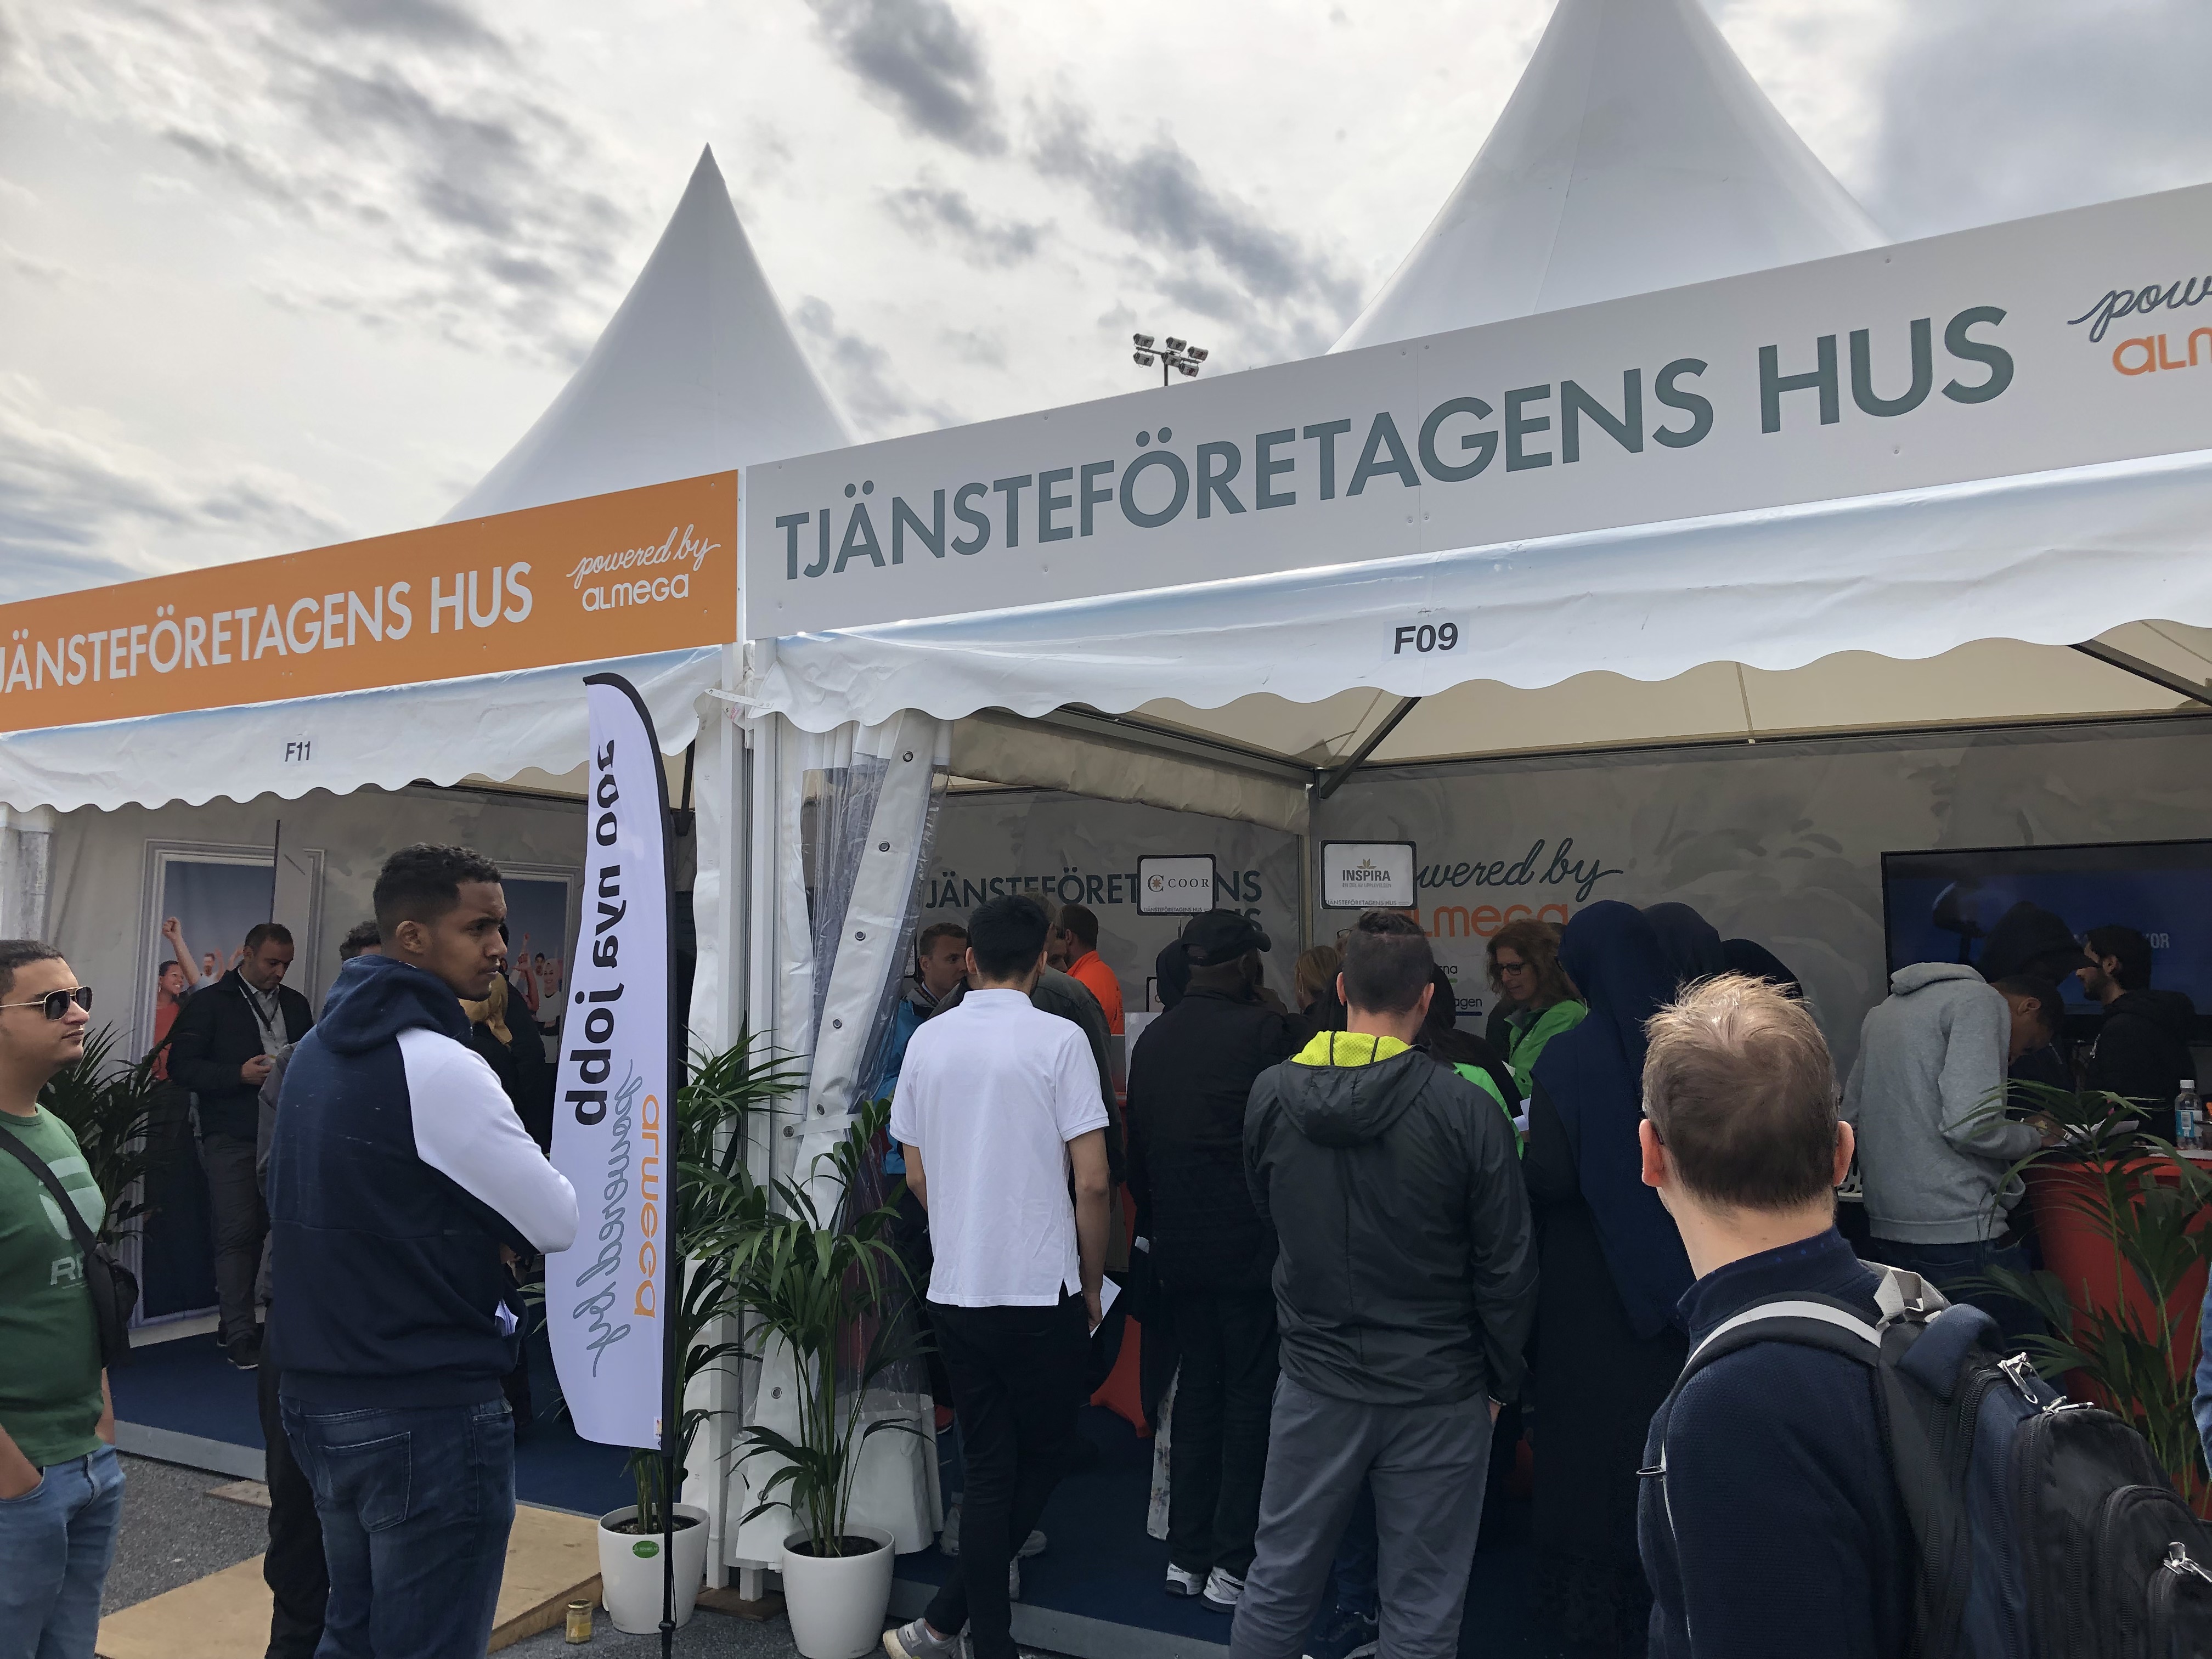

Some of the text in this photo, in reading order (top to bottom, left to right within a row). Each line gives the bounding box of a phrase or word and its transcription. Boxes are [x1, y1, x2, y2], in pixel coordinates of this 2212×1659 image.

[776, 306, 2014, 580] TJÄNSTEFÖRETAGENS HUS
[566, 523, 721, 590] powered by
[431, 561, 533, 634] HUS
[1393, 622, 1459, 654] F09
[285, 741, 311, 762] F11
[1168, 878, 1209, 888] COOR
[1342, 870, 1391, 881] INSPIRA
[1417, 837, 1624, 902] wered by
